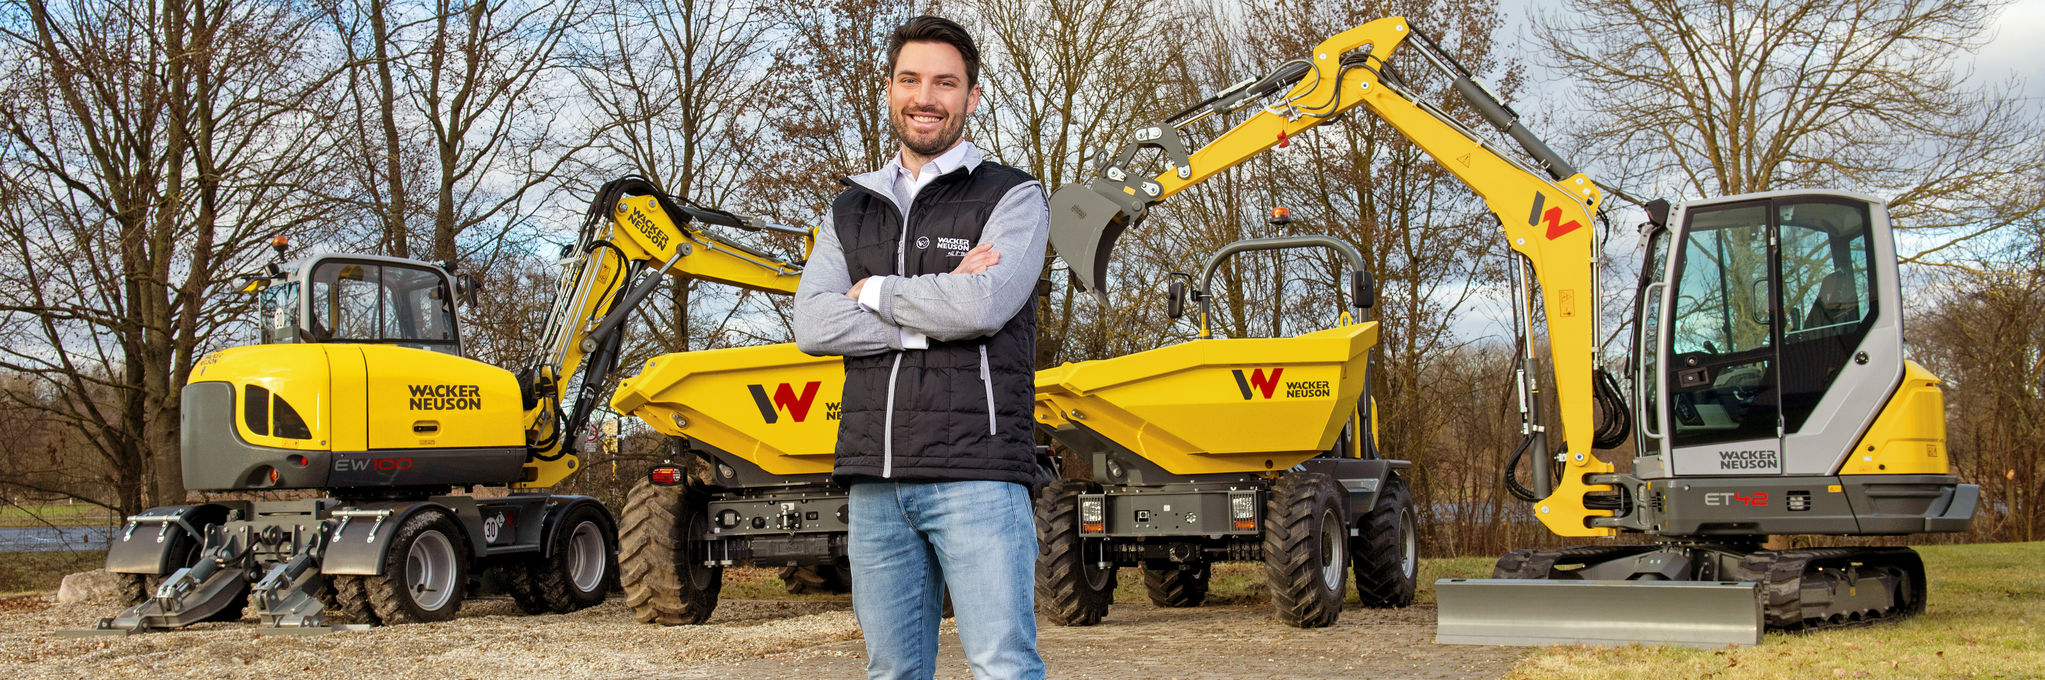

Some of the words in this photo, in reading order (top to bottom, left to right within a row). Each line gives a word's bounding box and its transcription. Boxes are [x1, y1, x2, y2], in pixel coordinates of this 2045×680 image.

[632, 206, 669, 244] WACKER
[627, 213, 666, 251] NEUSON
[936, 242, 970, 251] NEUSON
[937, 236, 970, 245] WACKER
[408, 385, 481, 397] WACKER
[1286, 381, 1330, 389] WACKER
[1286, 389, 1330, 398] NEUSON
[409, 398, 481, 410] NEUSON
[1719, 450, 1777, 460] WACKER
[334, 458, 413, 472] EW100
[1720, 460, 1778, 469] NEUSON
[1704, 492, 1769, 506] ET42
[486, 521, 496, 538] 30
